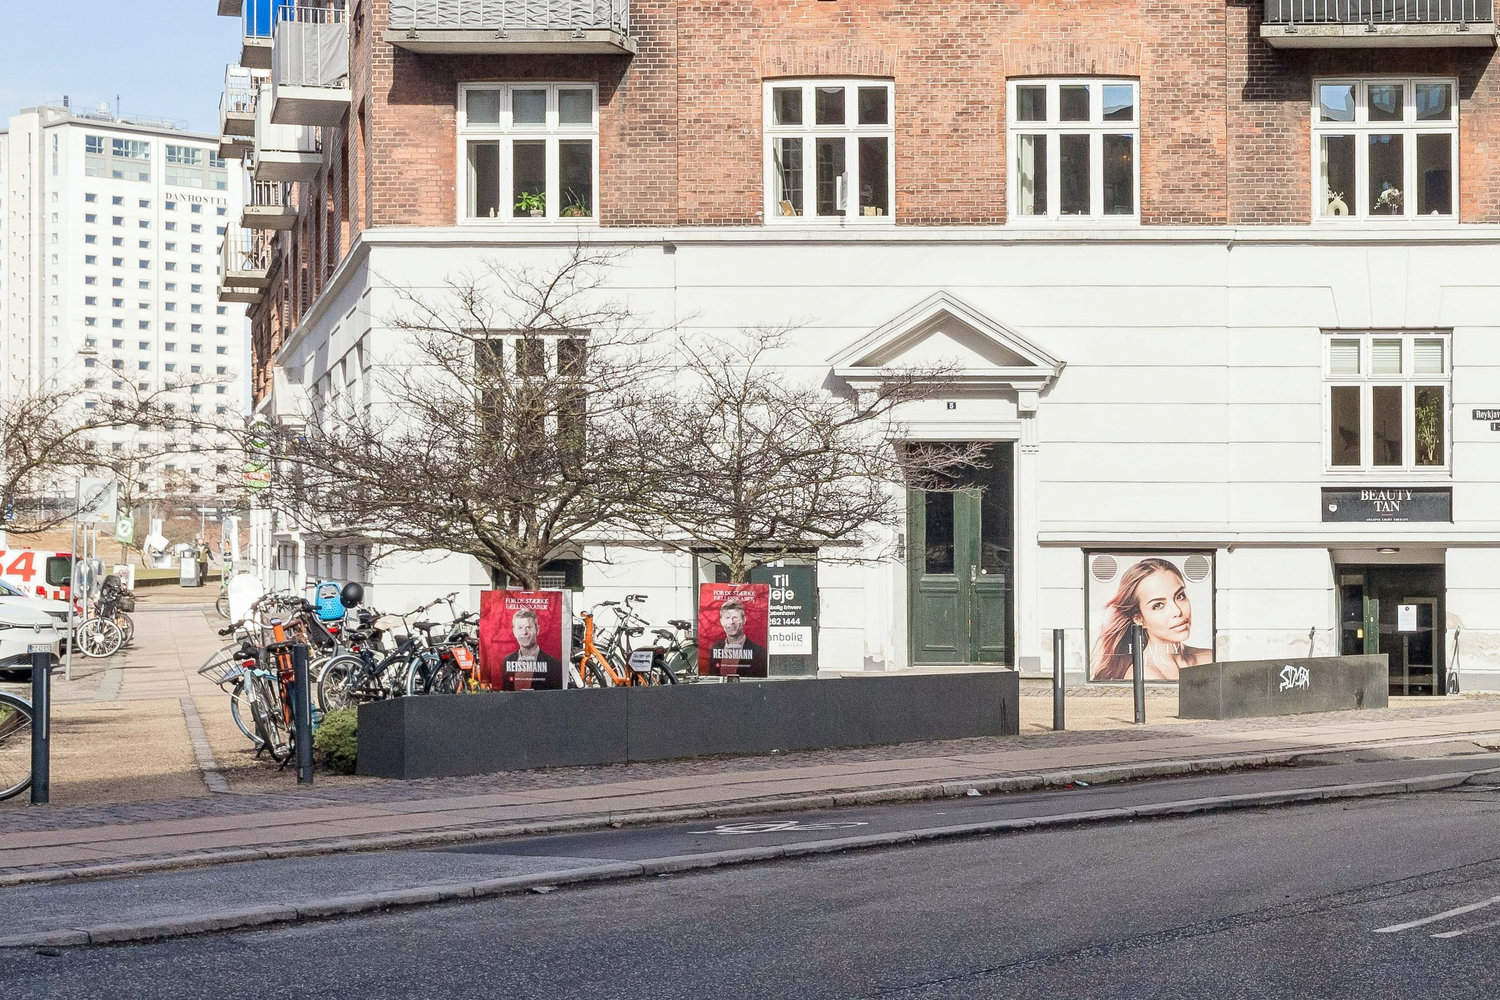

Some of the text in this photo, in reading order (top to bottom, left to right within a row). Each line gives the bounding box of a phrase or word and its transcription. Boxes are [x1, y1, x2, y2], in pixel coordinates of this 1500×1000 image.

[1360, 489, 1412, 501] BEAUTY
[1374, 500, 1400, 512] TAN
[0, 551, 36, 582] 4
[772, 574, 789, 587] Til
[713, 649, 753, 660] REISSMANN
[506, 661, 548, 673] REISSMANN
